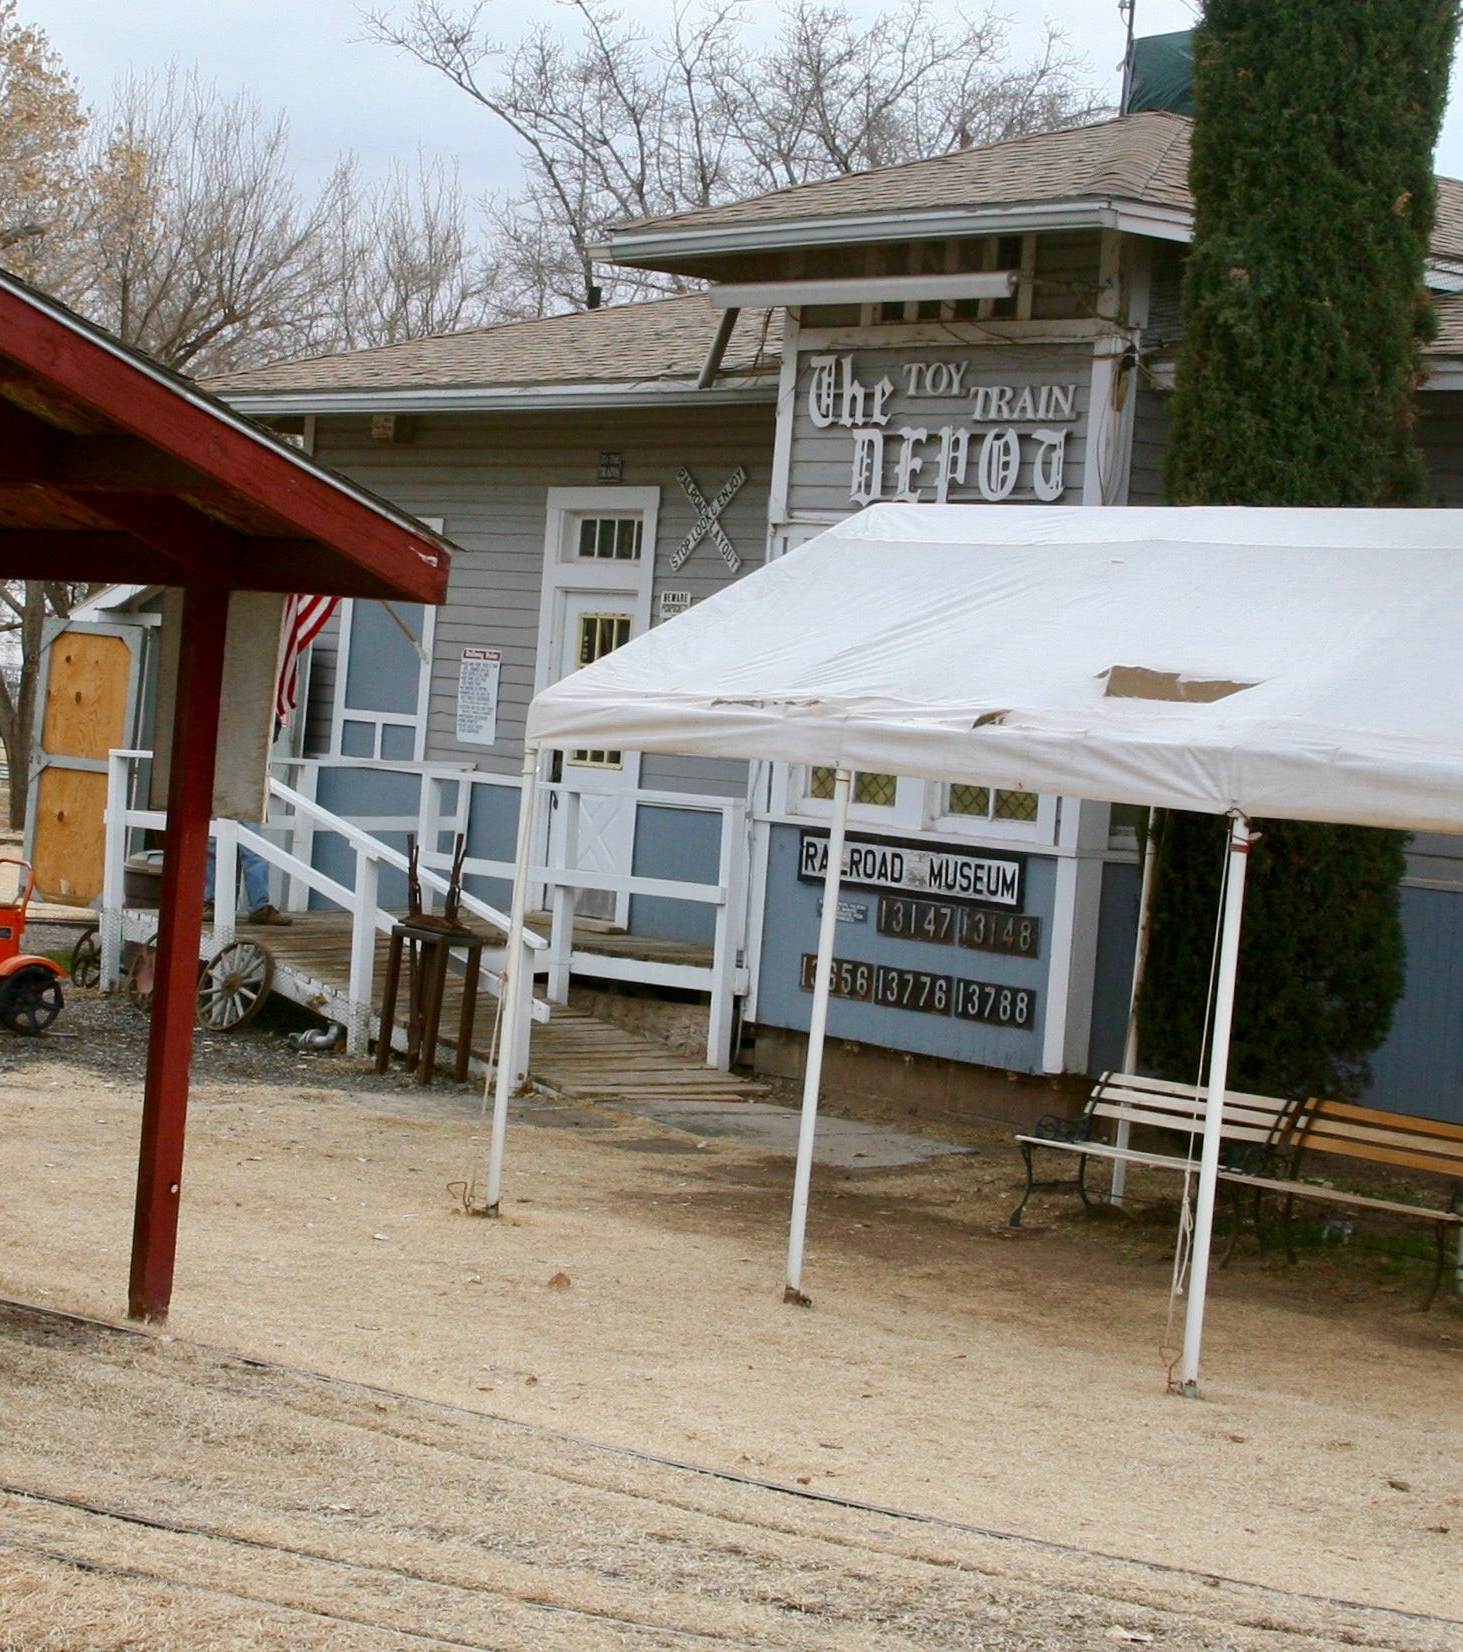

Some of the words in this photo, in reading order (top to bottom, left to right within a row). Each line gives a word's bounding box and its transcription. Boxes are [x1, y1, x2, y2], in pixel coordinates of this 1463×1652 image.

[808, 353, 895, 428] The
[903, 360, 970, 398] TOY
[970, 384, 1078, 422] TRAIN
[849, 425, 1071, 506] DEPOT
[670, 538, 691, 569] STOP
[691, 514, 713, 542] LOOK
[717, 469, 744, 508] ENJOY
[709, 520, 738, 569] LAYOUT
[804, 841, 904, 883] RAROAD
[928, 857, 1017, 899] MUSEUM
[881, 900, 951, 938] 13147
[962, 911, 1031, 951] 13148
[878, 969, 947, 1010] 13776
[958, 982, 1028, 1024] 13788
